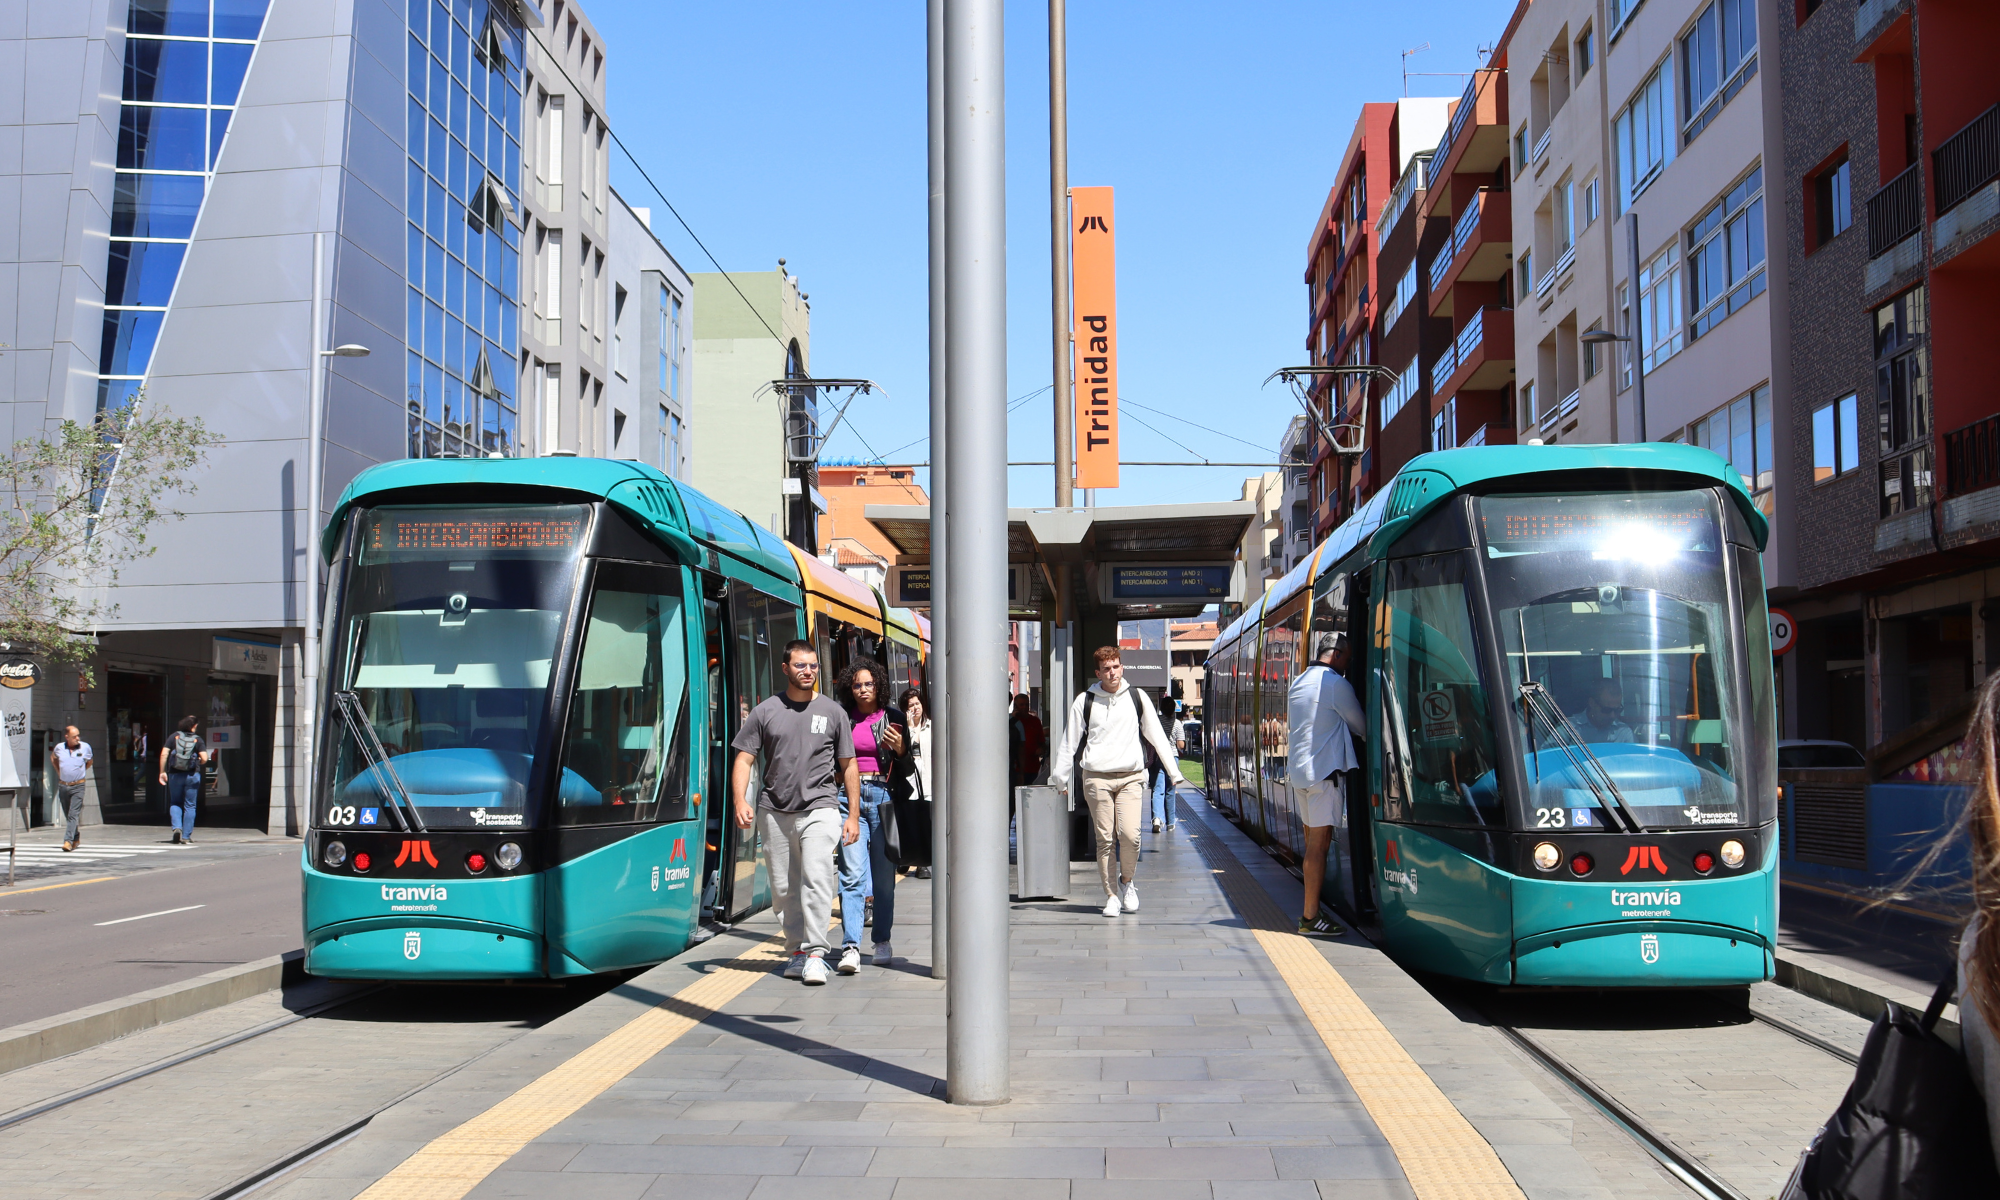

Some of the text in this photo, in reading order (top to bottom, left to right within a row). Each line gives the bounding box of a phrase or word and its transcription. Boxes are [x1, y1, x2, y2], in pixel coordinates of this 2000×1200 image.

[1082, 315, 1110, 452] Trinidad
[371, 523, 384, 548] 1
[396, 521, 574, 548] INTERCAMBIADOR
[18, 711, 26, 727] 2
[328, 805, 356, 826] 03
[486, 813, 523, 821] transporte
[1536, 807, 1566, 828] 23
[1701, 811, 1738, 819] transporte
[665, 864, 690, 881] tranvía
[381, 884, 448, 901] tranvía
[1611, 888, 1682, 906] tranvía
[391, 903, 438, 912] metrotenerife
[1621, 908, 1672, 917] metrotenerife
